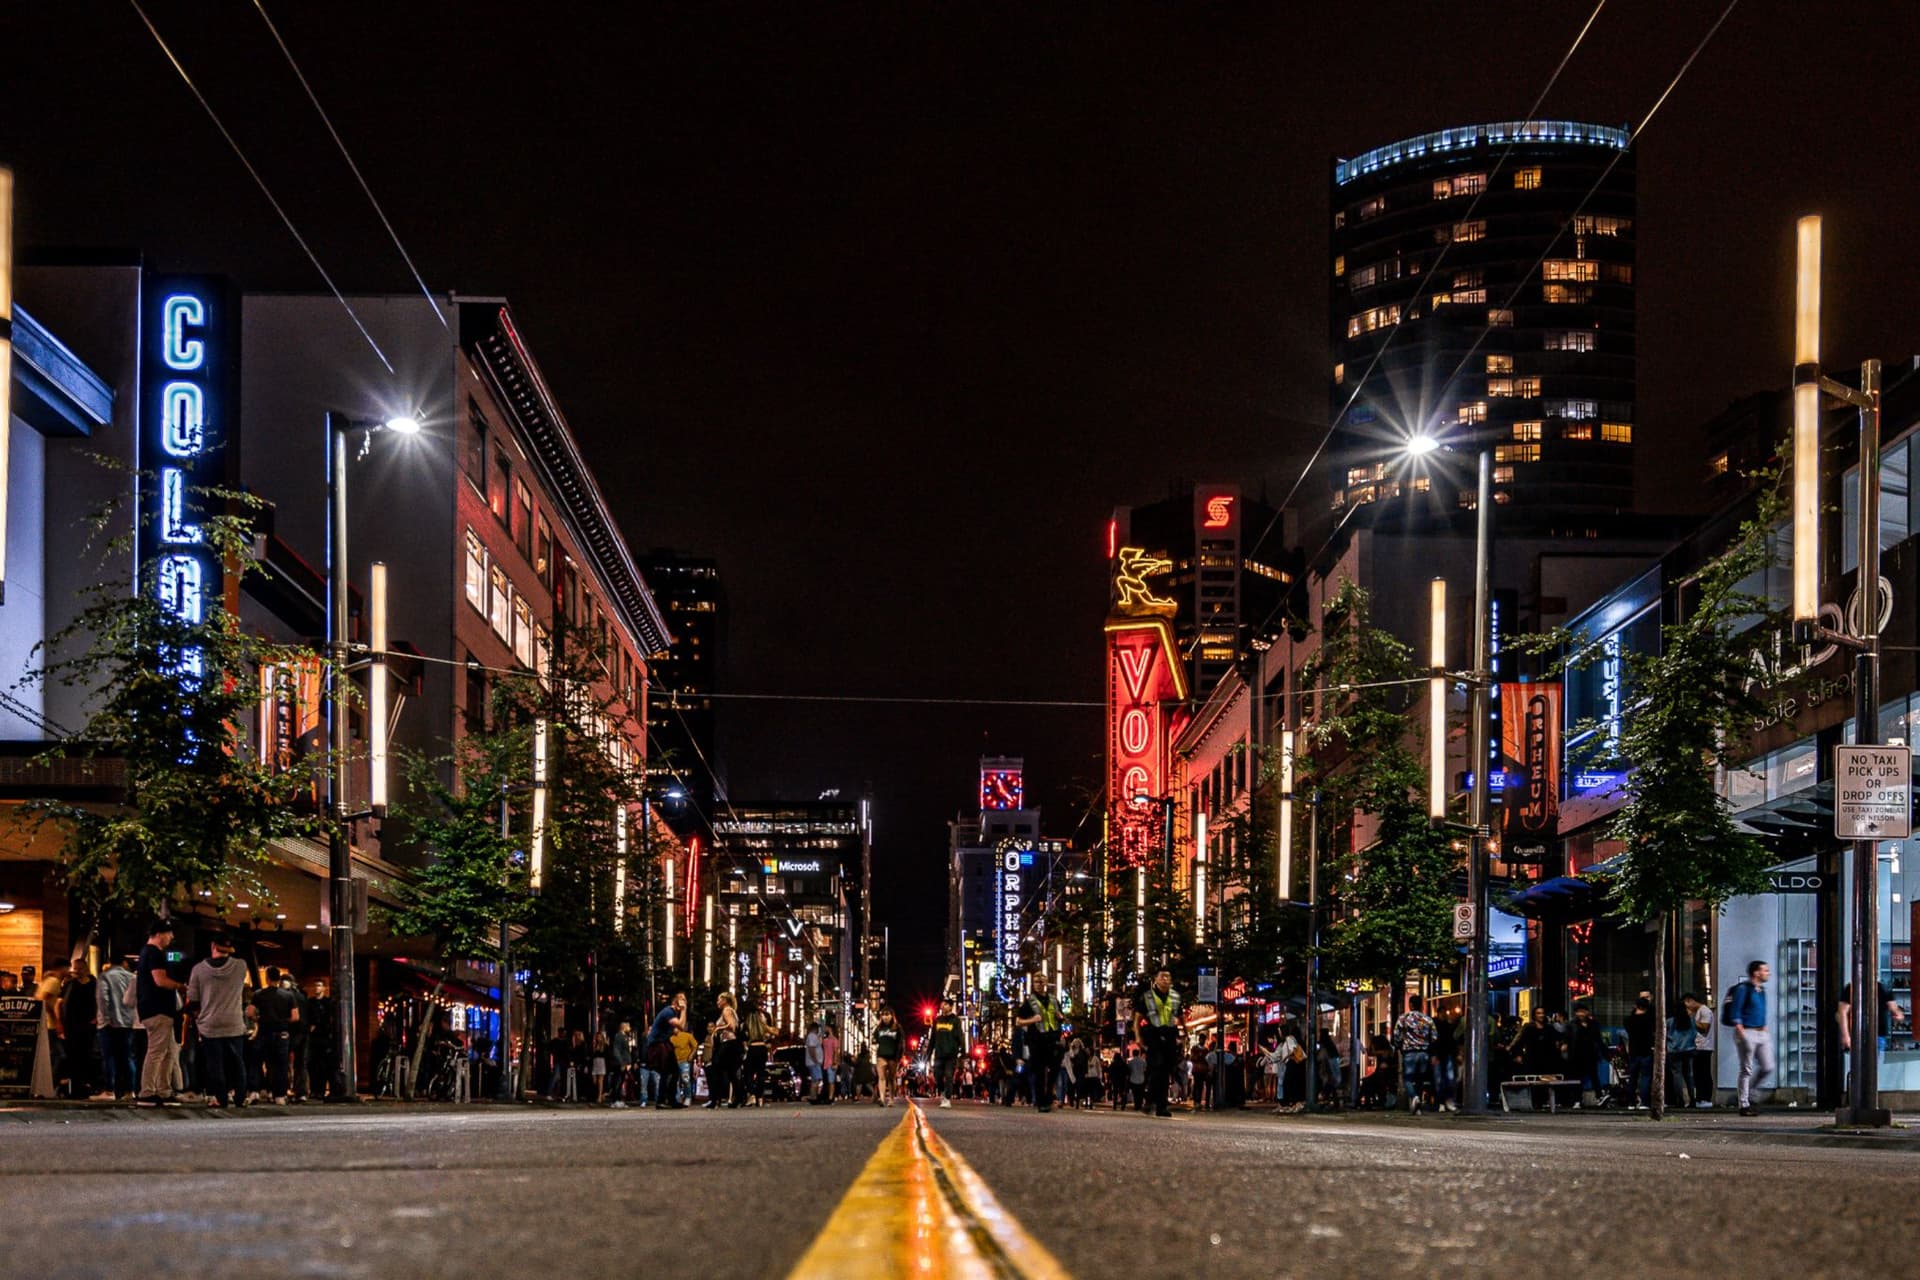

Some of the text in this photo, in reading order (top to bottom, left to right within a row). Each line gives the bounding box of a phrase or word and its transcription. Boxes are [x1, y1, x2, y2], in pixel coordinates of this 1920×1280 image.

[1851, 755, 1897, 765] NO TAXI
[1848, 766, 1900, 777] PICK UPS
[1866, 778, 1881, 788] OR
[1843, 791, 1905, 801] DROP OFFS
[779, 861, 820, 872] Microsoft
[1768, 876, 1823, 889] ALDO
[1004, 851, 1021, 978] ORPHEU
